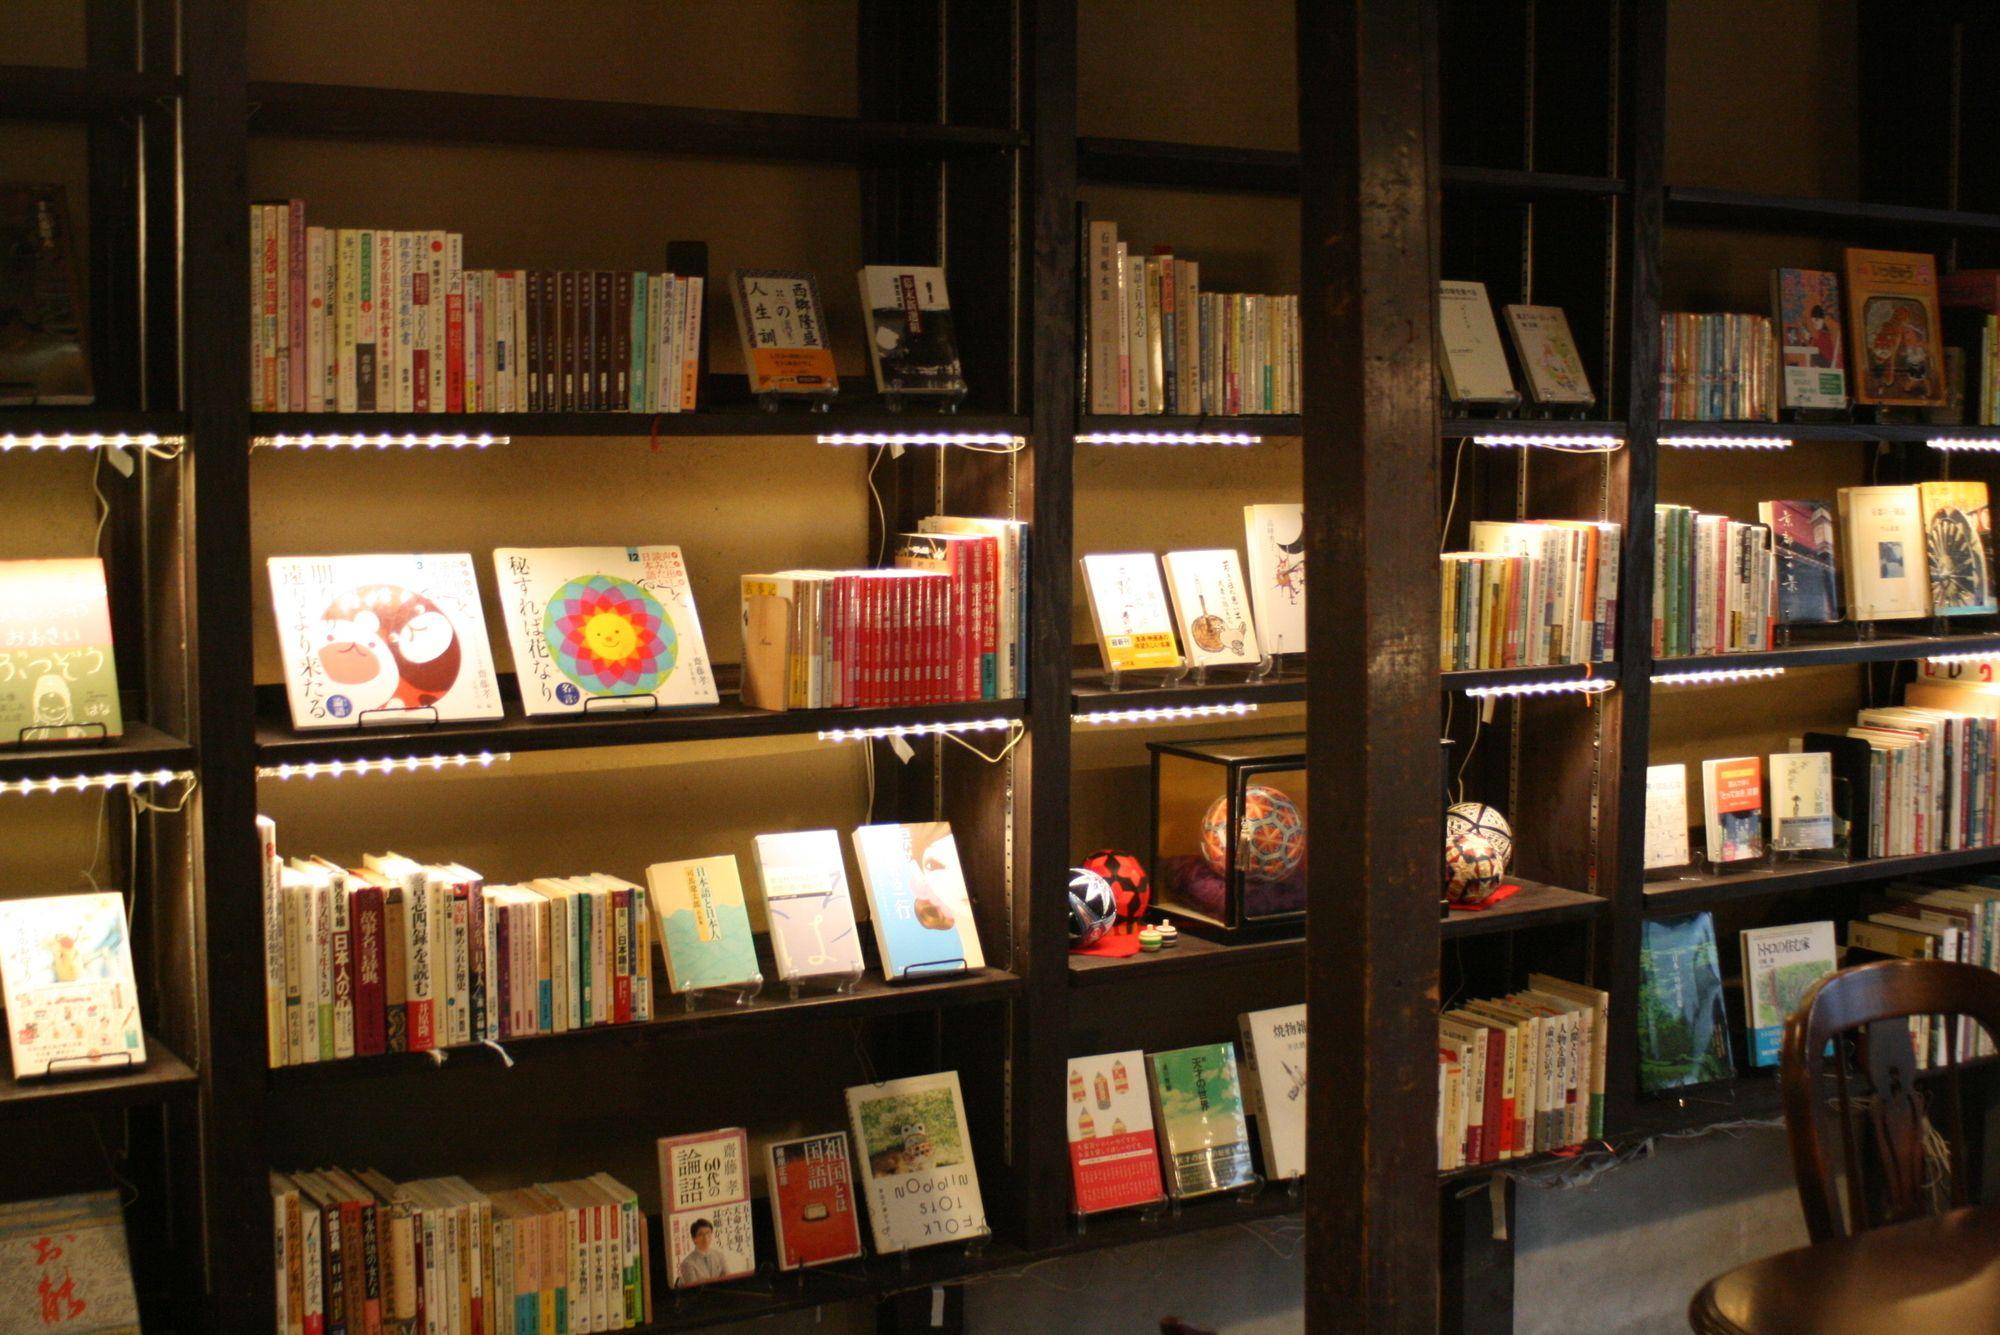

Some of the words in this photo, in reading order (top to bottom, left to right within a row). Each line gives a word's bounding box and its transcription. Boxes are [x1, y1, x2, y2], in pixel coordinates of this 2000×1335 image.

[749, 281, 778, 347] 人生訓
[628, 553, 639, 562] 12
[509, 555, 553, 703] 秘すれば花なり
[696, 866, 721, 941] 日本語と日本人
[412, 876, 430, 997] 言志四録を読む
[335, 934, 352, 1010] 日本人の心
[1192, 1057, 1211, 1111] 天才の世界
[677, 1148, 704, 1205] 論語
[704, 1157, 721, 1197] 60代の
[804, 1140, 828, 1191] 国語
[825, 1137, 848, 1213] 祖国とは
[894, 1174, 969, 1199] NIPPON
[919, 1196, 963, 1215] TOYS
[924, 1214, 973, 1236] FOLK
